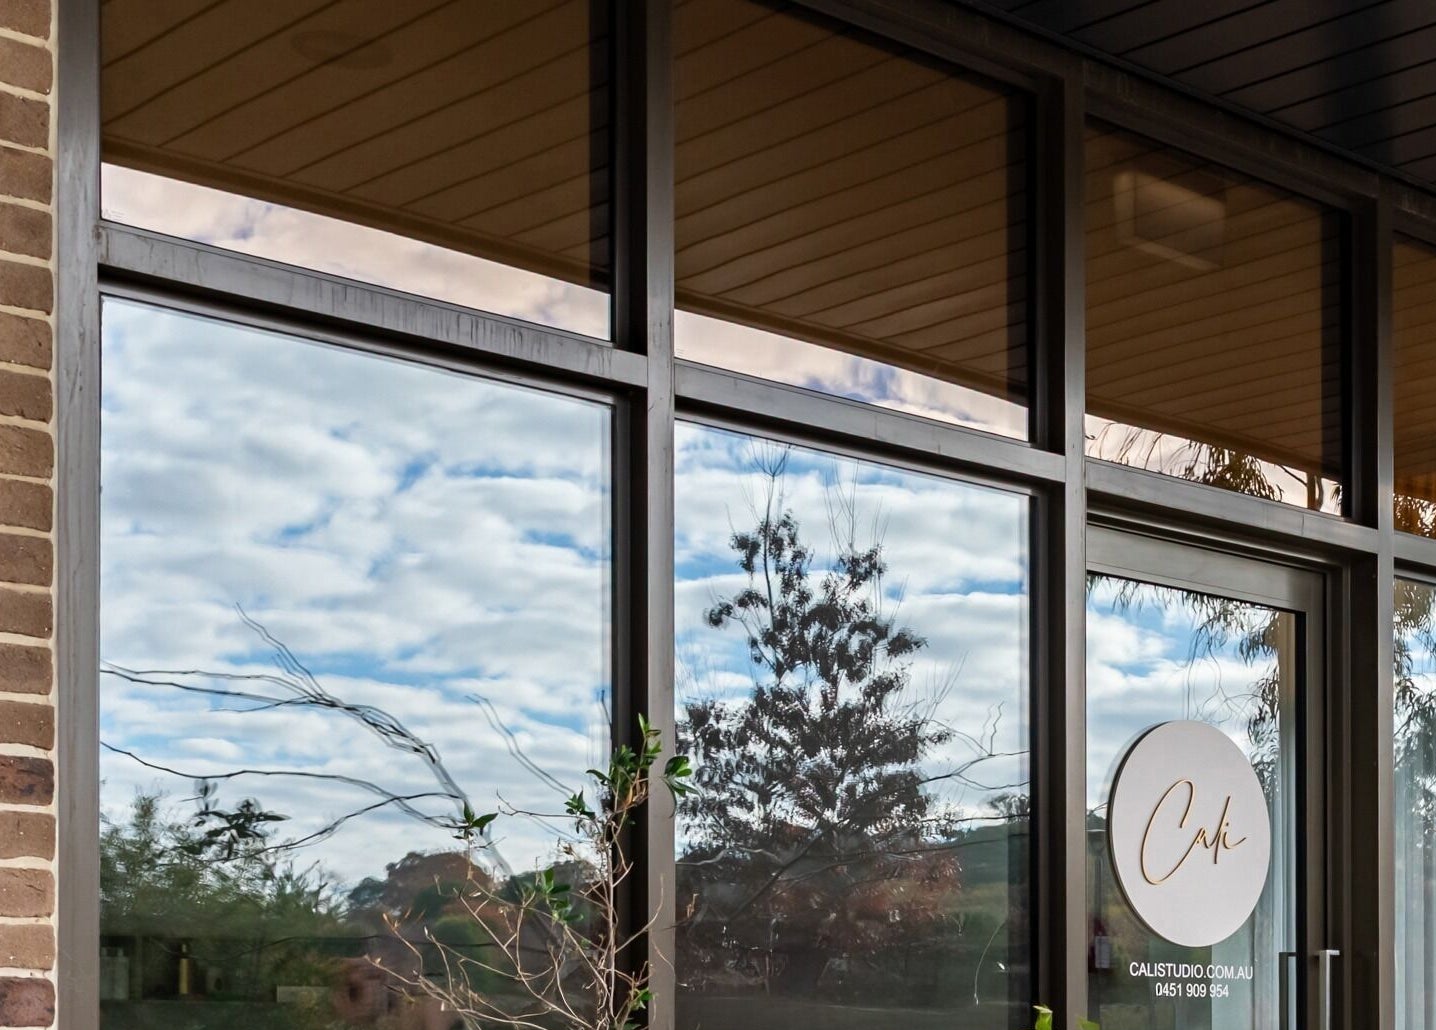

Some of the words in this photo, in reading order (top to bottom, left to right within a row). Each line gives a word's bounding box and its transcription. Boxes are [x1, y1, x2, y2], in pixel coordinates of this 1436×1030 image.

[1141, 779, 1246, 885] Cali
[1129, 961, 1253, 980] CALISTUDIO.COM.AU
[1155, 982, 1182, 997] 0451
[1186, 983, 1207, 998] 909
[1209, 984, 1229, 998] 954
